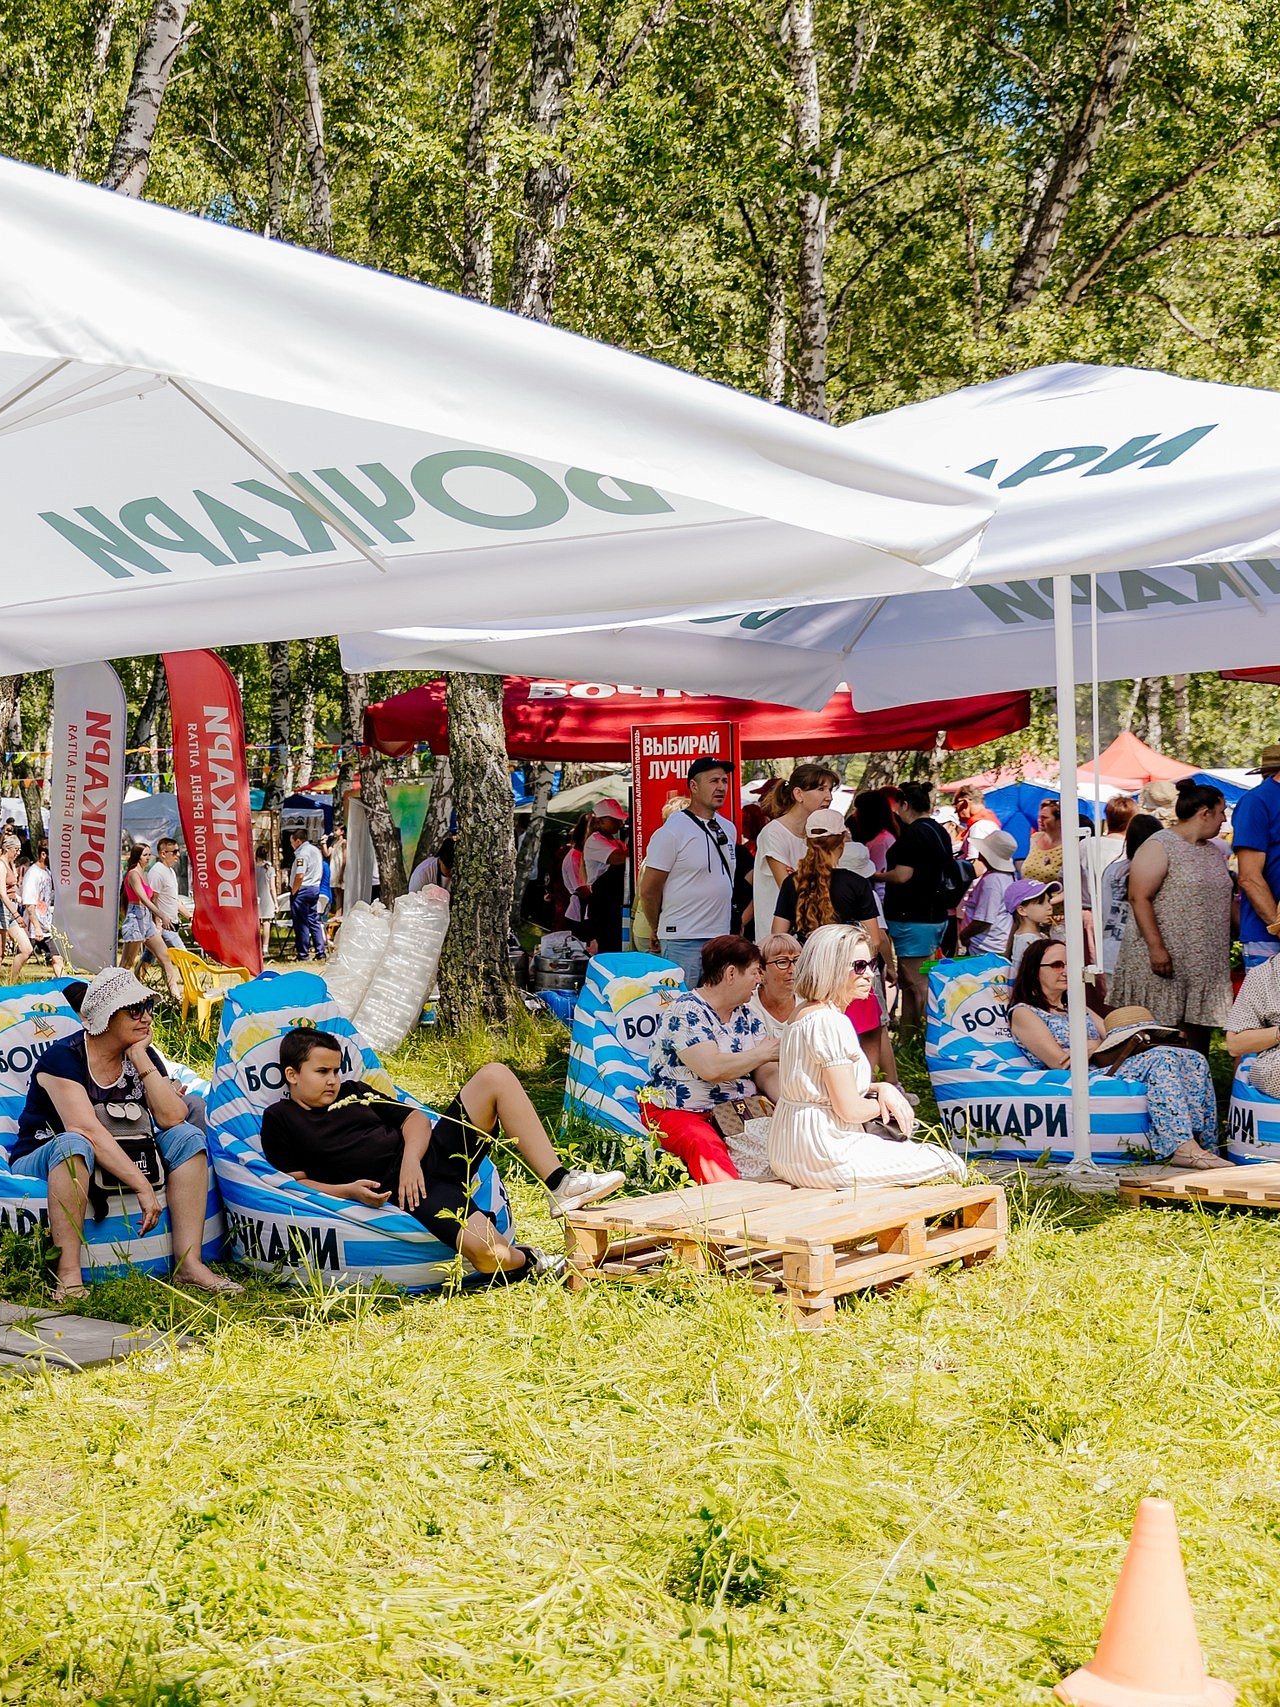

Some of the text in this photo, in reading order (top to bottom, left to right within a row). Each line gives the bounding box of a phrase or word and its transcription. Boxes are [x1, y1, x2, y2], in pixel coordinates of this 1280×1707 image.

[642, 731, 720, 756] ВЫБИРАЙ
[648, 759, 696, 780] ЛУЧШ
[223, 1206, 340, 1271] ОЧКАРИ
